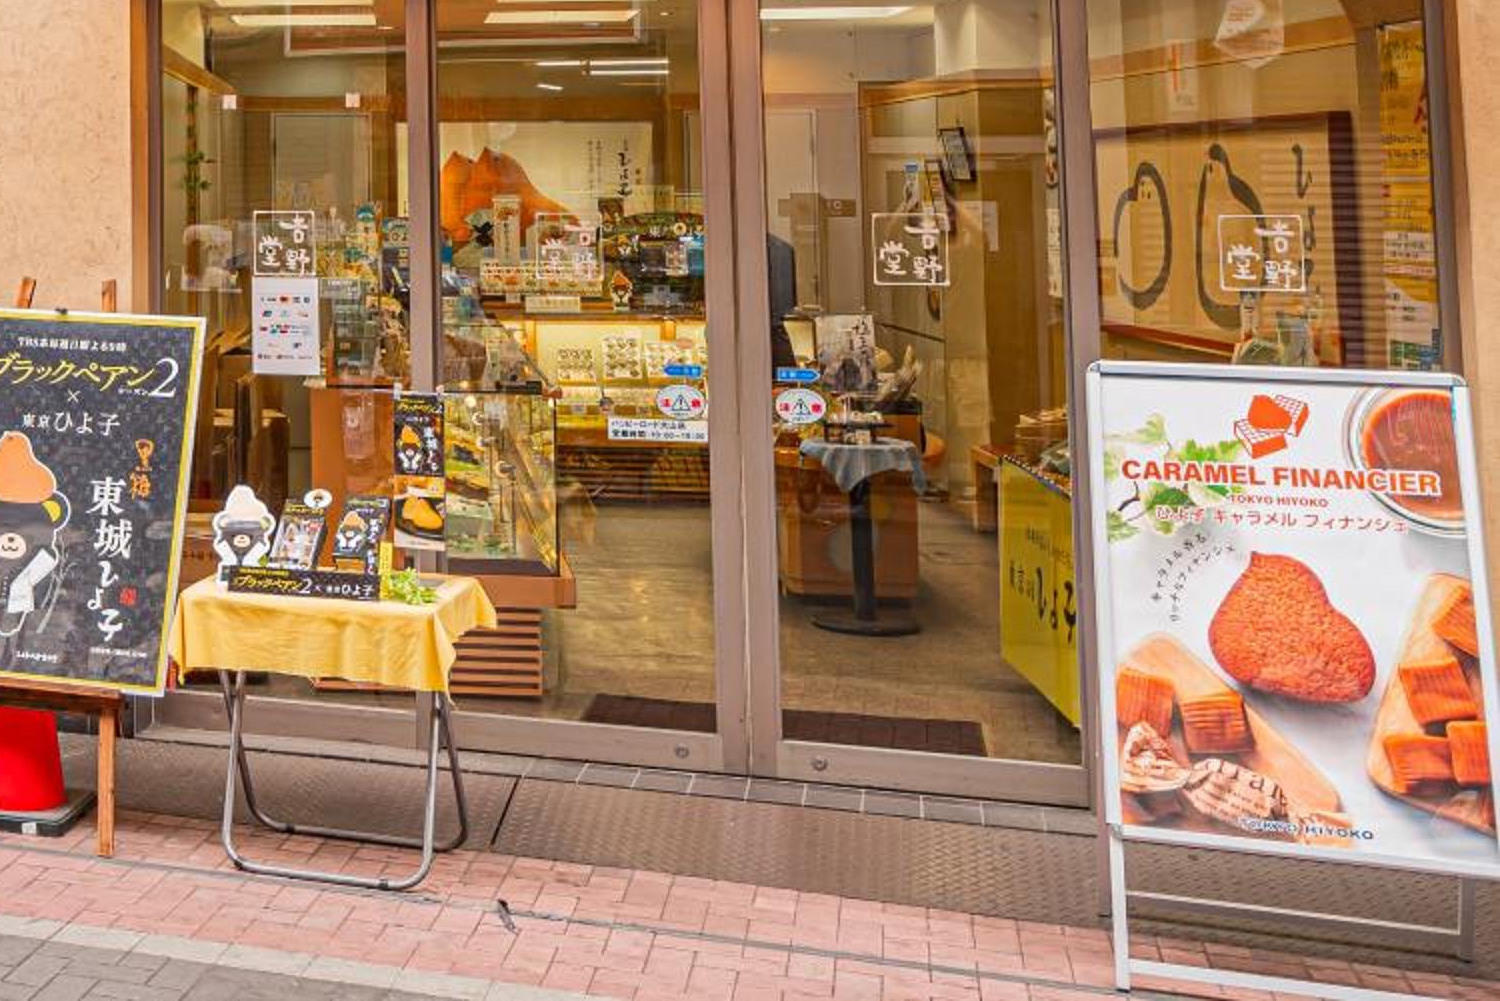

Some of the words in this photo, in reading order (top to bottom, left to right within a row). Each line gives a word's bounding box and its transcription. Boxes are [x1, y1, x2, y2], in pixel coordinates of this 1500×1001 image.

[148, 357, 179, 398] 2
[1122, 459, 1267, 486] CARAMEL
[1272, 467, 1441, 496] FINANCIER
[1229, 494, 1273, 505] TOKYO
[1276, 496, 1329, 508] HIYOKO
[1213, 507, 1297, 528] キャラメル
[1305, 514, 1407, 532] フィナンシェ
[85, 476, 133, 642] 東城ひよ子
[1305, 825, 1374, 840] HIYOKO
